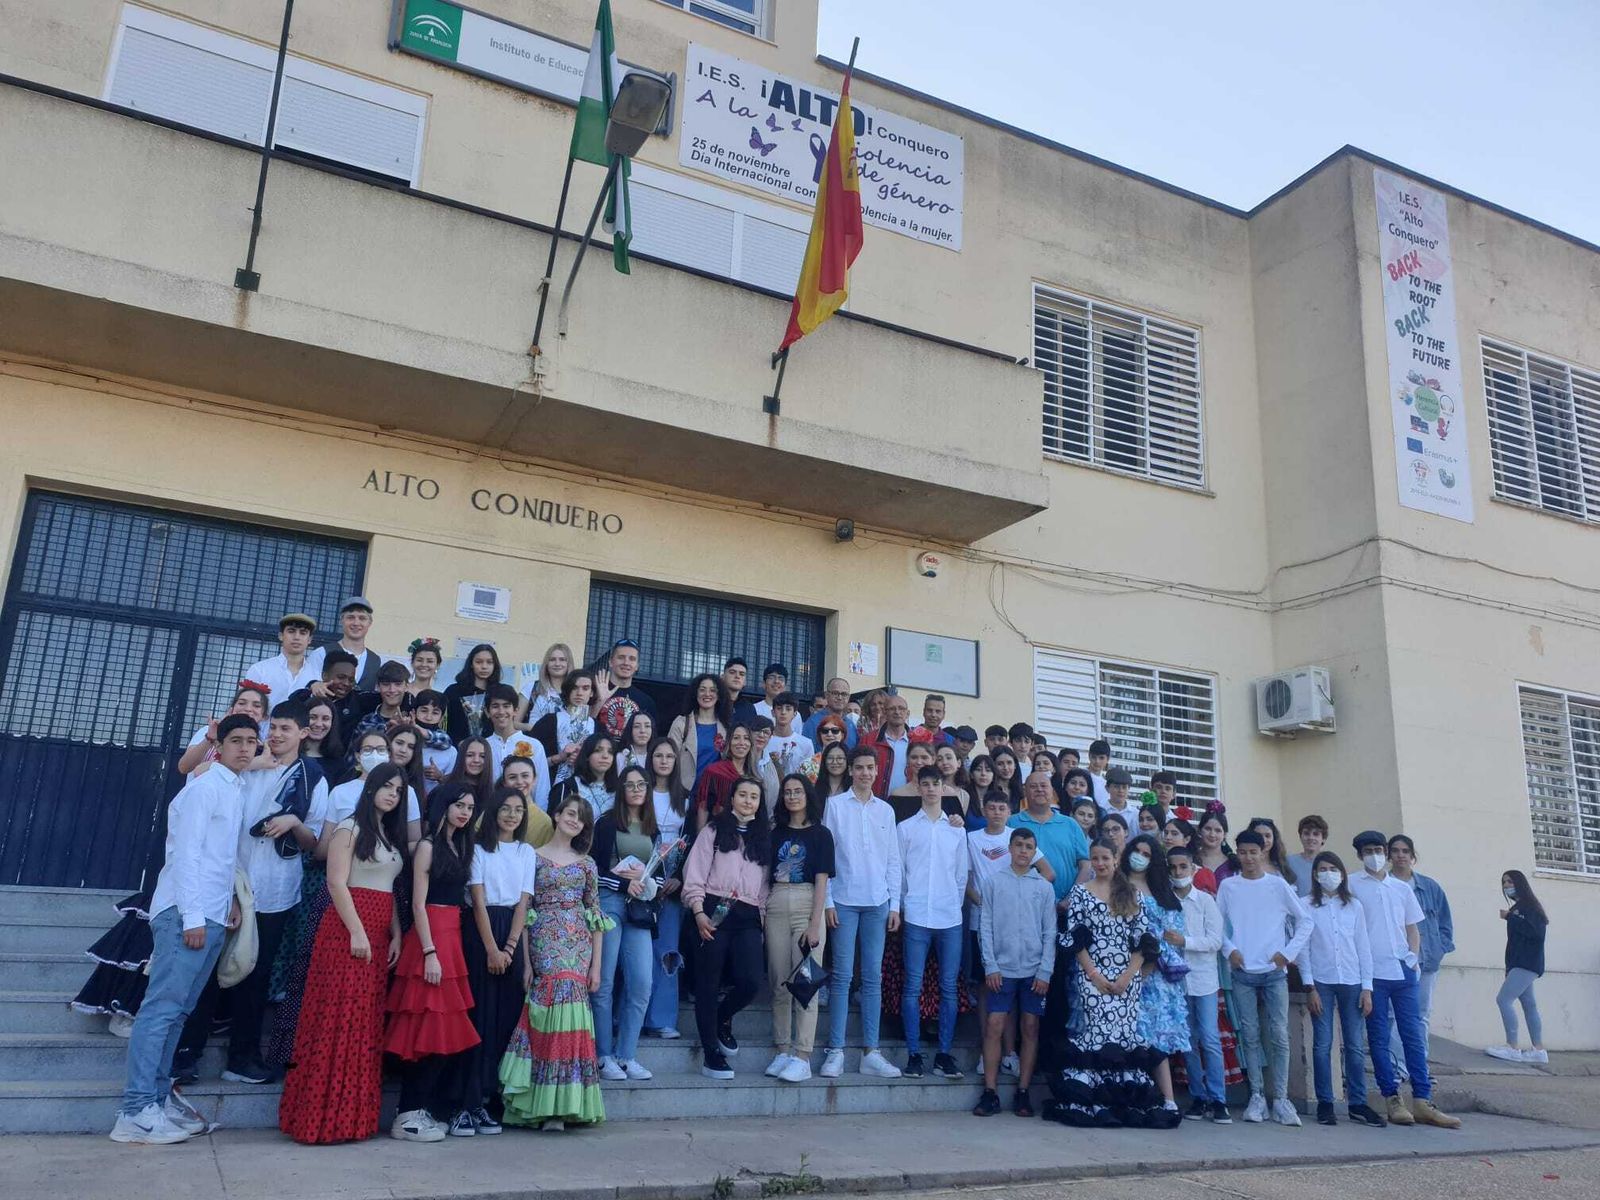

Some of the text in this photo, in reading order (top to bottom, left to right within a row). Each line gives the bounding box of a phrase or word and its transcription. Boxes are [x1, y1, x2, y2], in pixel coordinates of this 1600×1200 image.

[489, 38, 584, 78] Instituto de Educac
[698, 62, 746, 91] I.E.S.
[876, 126, 950, 160] Conquero
[696, 89, 951, 186] A la iolencia
[691, 137, 791, 178] 25 de noviembre
[714, 157, 793, 191] Internacional
[899, 217, 907, 228] a
[908, 219, 919, 232] la
[920, 226, 953, 242] mujer.
[856, 162, 954, 214] de género
[1398, 190, 1422, 211] I.E.S.
[1387, 249, 1423, 282] BACK
[1408, 273, 1442, 296] TO THE
[1409, 290, 1437, 309] ROOT
[1394, 304, 1431, 338] BACK
[1411, 331, 1445, 353] TO THE
[1412, 348, 1451, 371] FUTURE
[362, 469, 623, 534] ALTO CONQUERO
